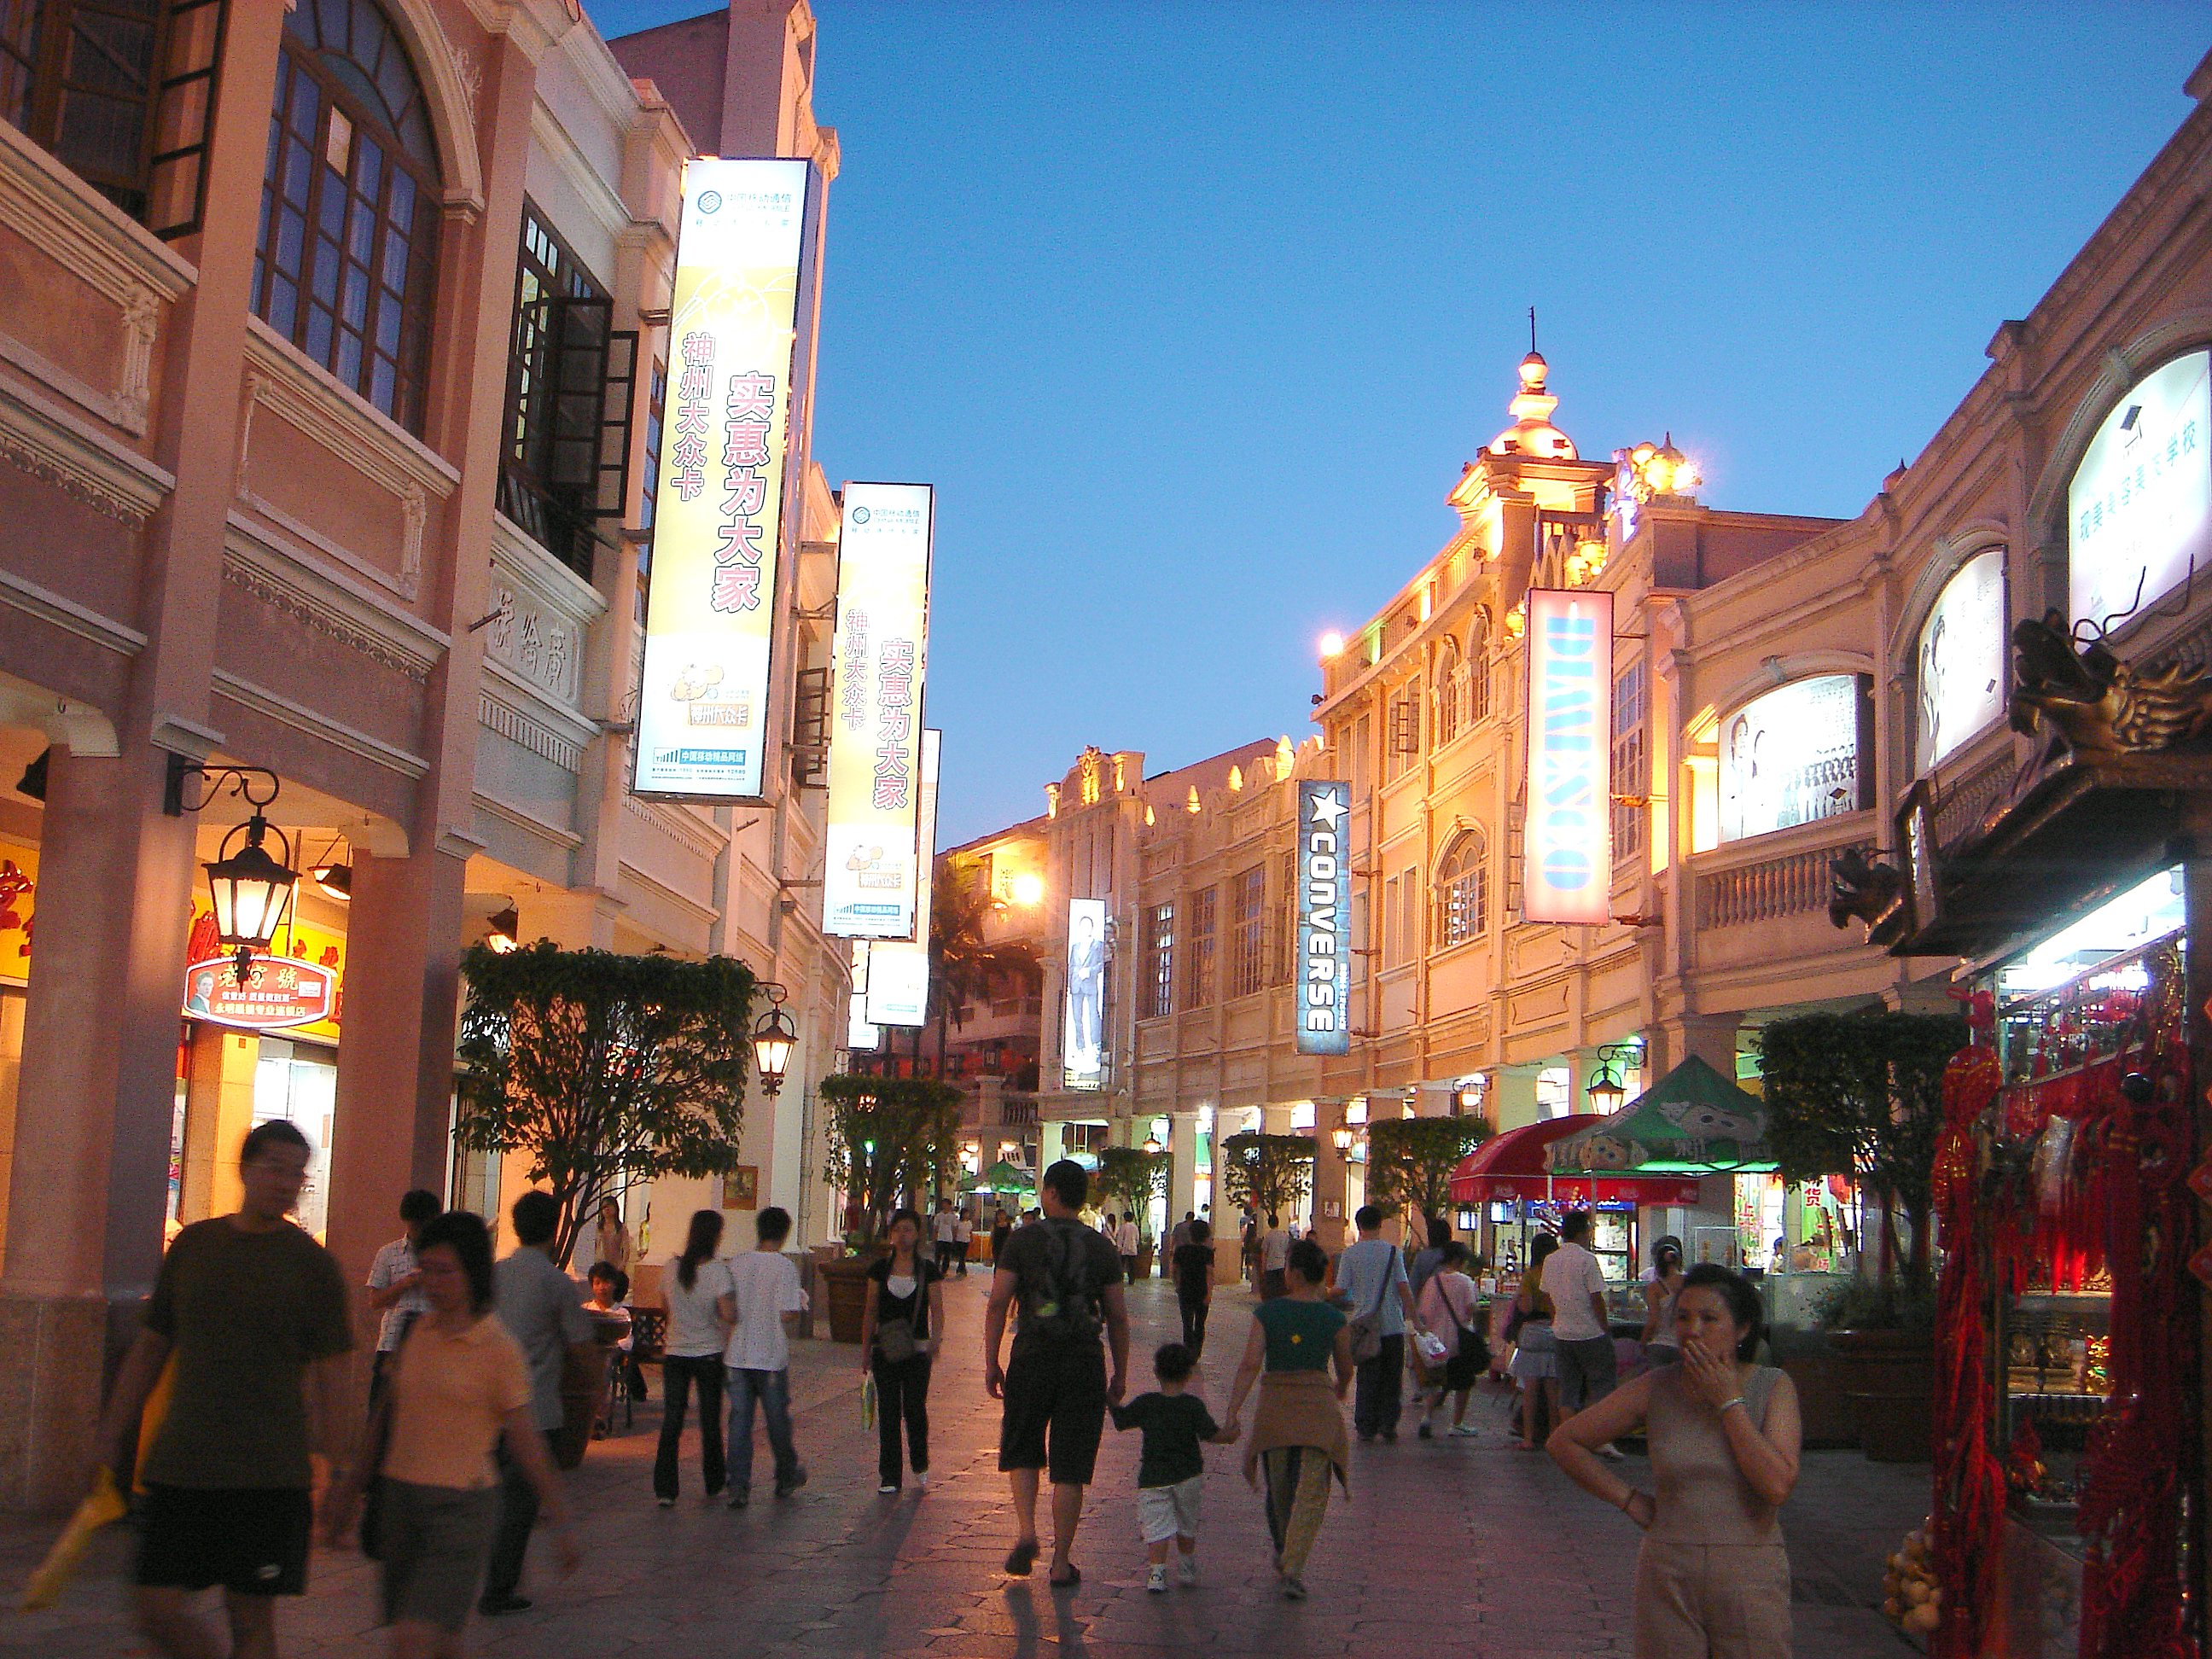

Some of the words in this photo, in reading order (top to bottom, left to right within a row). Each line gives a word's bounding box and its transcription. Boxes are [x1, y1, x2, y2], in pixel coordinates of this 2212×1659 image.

[672, 332, 716, 502] 神州大众卡
[711, 371, 775, 613] 实惠为大家
[841, 608, 870, 731] 神州大众卡
[873, 637, 914, 810] 实惠为大家
[1307, 831, 1337, 1033] CONVERSE
